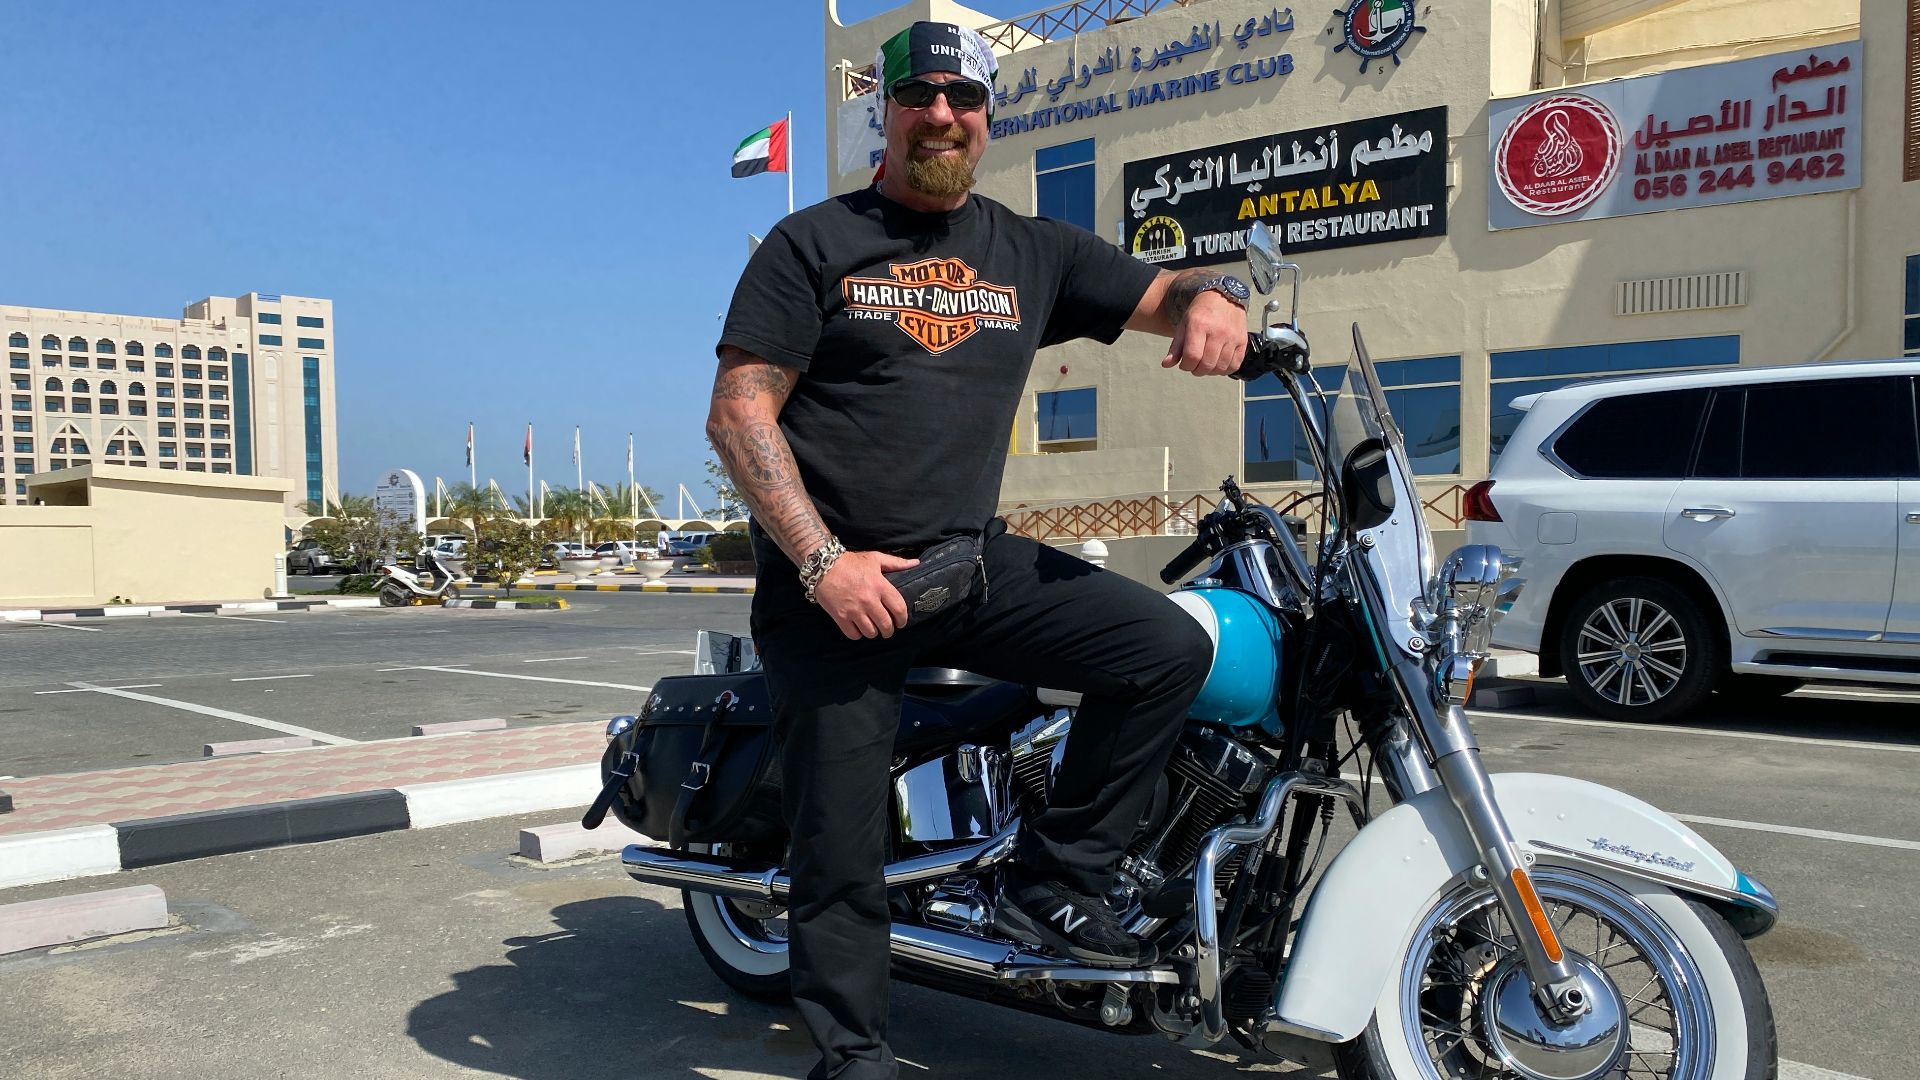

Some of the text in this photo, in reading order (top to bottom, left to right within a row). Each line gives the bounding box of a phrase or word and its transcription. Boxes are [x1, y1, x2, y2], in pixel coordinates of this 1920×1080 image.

[1131, 20, 1221, 72] الفجيرة
[1234, 7, 1294, 49] نادي
[1046, 45, 1120, 102] الدولي
[1770, 54, 1850, 93] مطعم
[990, 53, 1295, 140] ERNATIONAL MARINE CLUB
[1634, 85, 1846, 150] الدار الأصيل
[1131, 123, 1433, 218] مطعم أنطاليا التركي
[1635, 127, 1846, 176] AL DAAR AL ASEEL RESTAURANT
[1528, 182, 1586, 197] Restaurant
[1534, 180, 1556, 189] DAAR
[1556, 178, 1567, 186] AL
[1568, 175, 1592, 184] ASEEL
[1633, 152, 1846, 201] 056 244 9462
[1237, 179, 1381, 221] ANTALYA
[1138, 216, 1178, 238] ANTALYA
[1192, 203, 1433, 257] TURKH RESTAURANT
[1142, 252, 1178, 263] ESTAURANT
[1144, 248, 1171, 257] TURKISH
[900, 261, 966, 285] MOTOR
[848, 310, 892, 321] TRADE
[852, 284, 1013, 316] HARLEY-DAVIDSON
[904, 315, 971, 348] CYCLES
[1049, 904, 1088, 934] N
